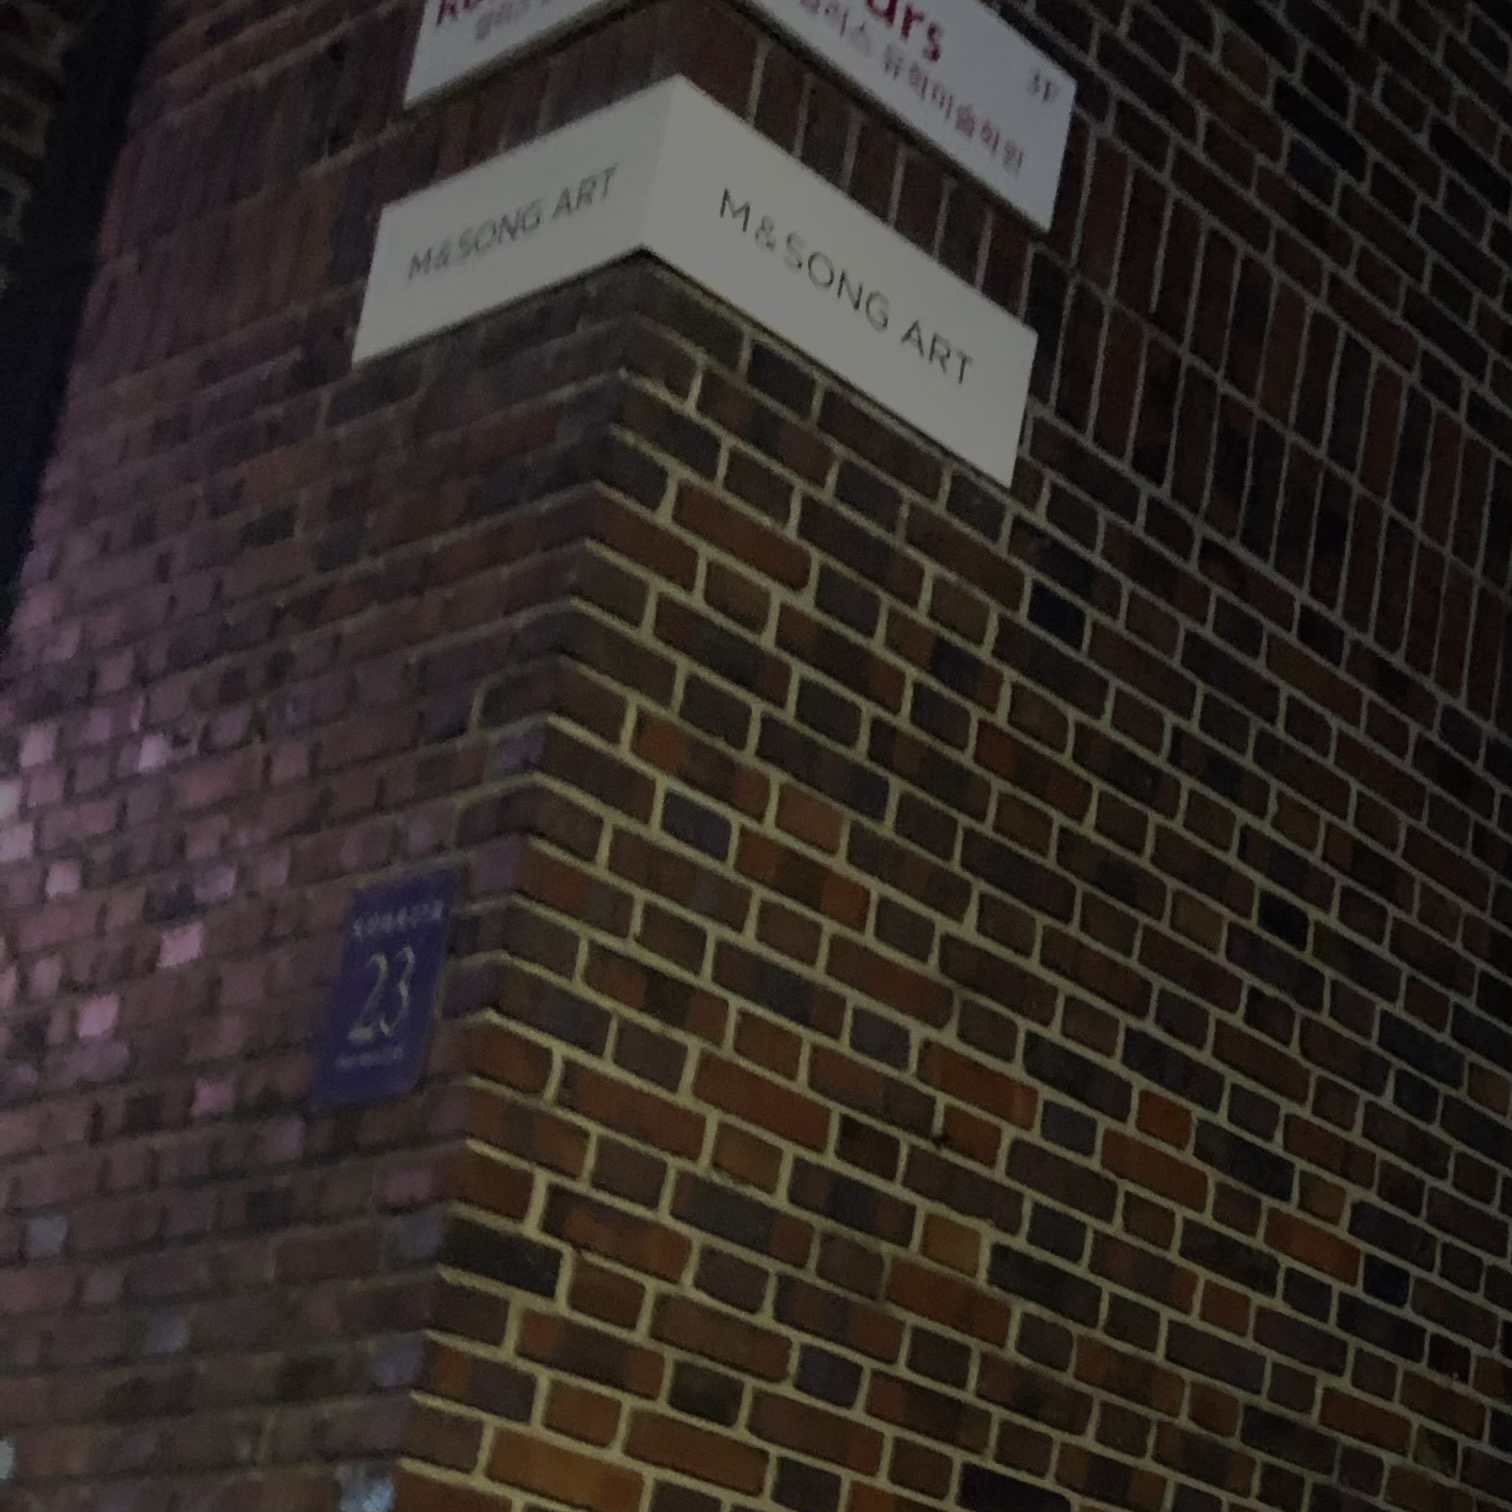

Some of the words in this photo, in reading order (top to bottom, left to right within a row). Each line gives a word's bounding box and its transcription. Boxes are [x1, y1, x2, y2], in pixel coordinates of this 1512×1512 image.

[408, 198, 544, 281] M&SONG
[551, 163, 617, 222] ART
[719, 187, 890, 333] M&SONG
[901, 319, 972, 385] ART
[347, 945, 416, 1041] 23
